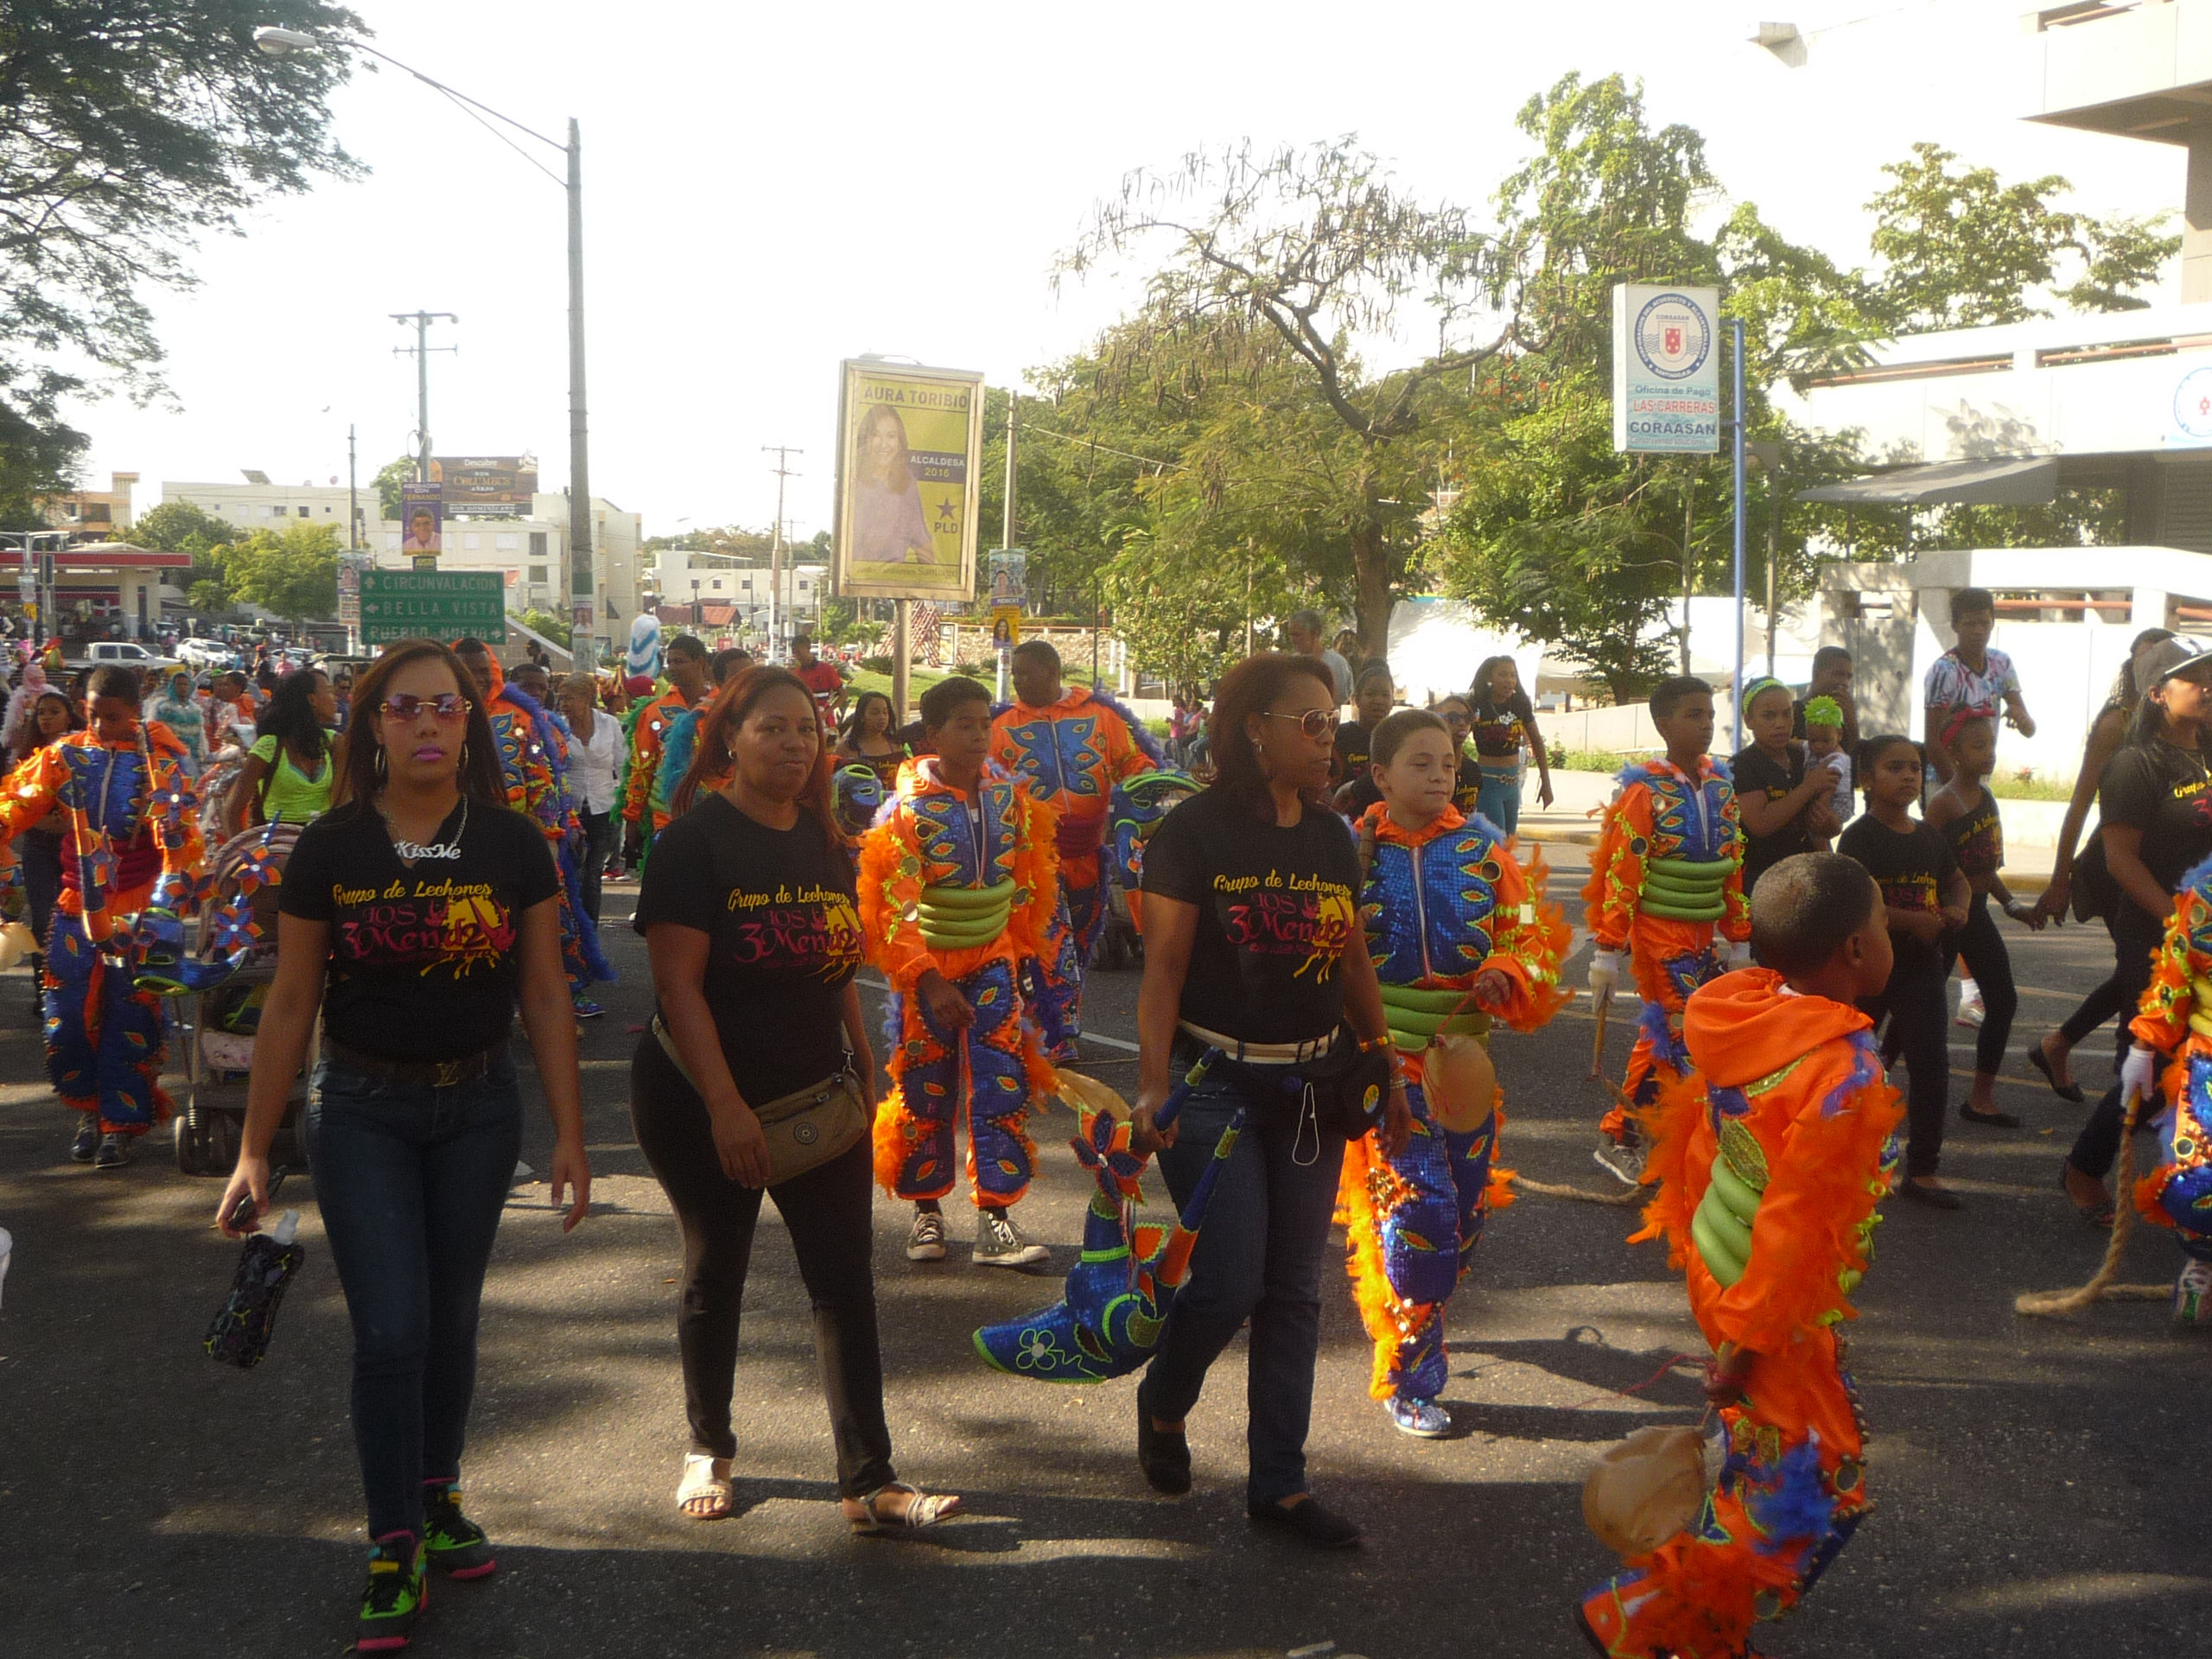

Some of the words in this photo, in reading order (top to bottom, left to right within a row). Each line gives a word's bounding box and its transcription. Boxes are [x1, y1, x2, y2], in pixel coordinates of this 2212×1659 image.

[865, 387, 905, 403] AURA
[910, 391, 969, 408] TORIBIO
[1636, 385, 1669, 395] Oficina
[1687, 387, 1711, 397] Pago
[1633, 399, 1654, 412] LAS
[1657, 400, 1715, 414] CARRERAS
[1630, 422, 1715, 435] CORAASAN
[910, 455, 965, 467] ALCALDESA
[925, 467, 950, 478] 2016
[934, 522, 958, 534] PLD
[383, 576, 498, 590] CIRCUNVALACION
[384, 601, 440, 615] BELLA
[454, 602, 497, 615] VISTA
[1213, 874, 1260, 894] Grupo
[1265, 868, 1283, 888] de
[1288, 873, 1352, 896] Lechones
[333, 883, 378, 908] Grupo
[383, 879, 406, 899] de
[413, 877, 493, 898] Lechones
[728, 888, 771, 912] Grupo
[775, 884, 792, 904] de
[798, 883, 850, 906] Lechones
